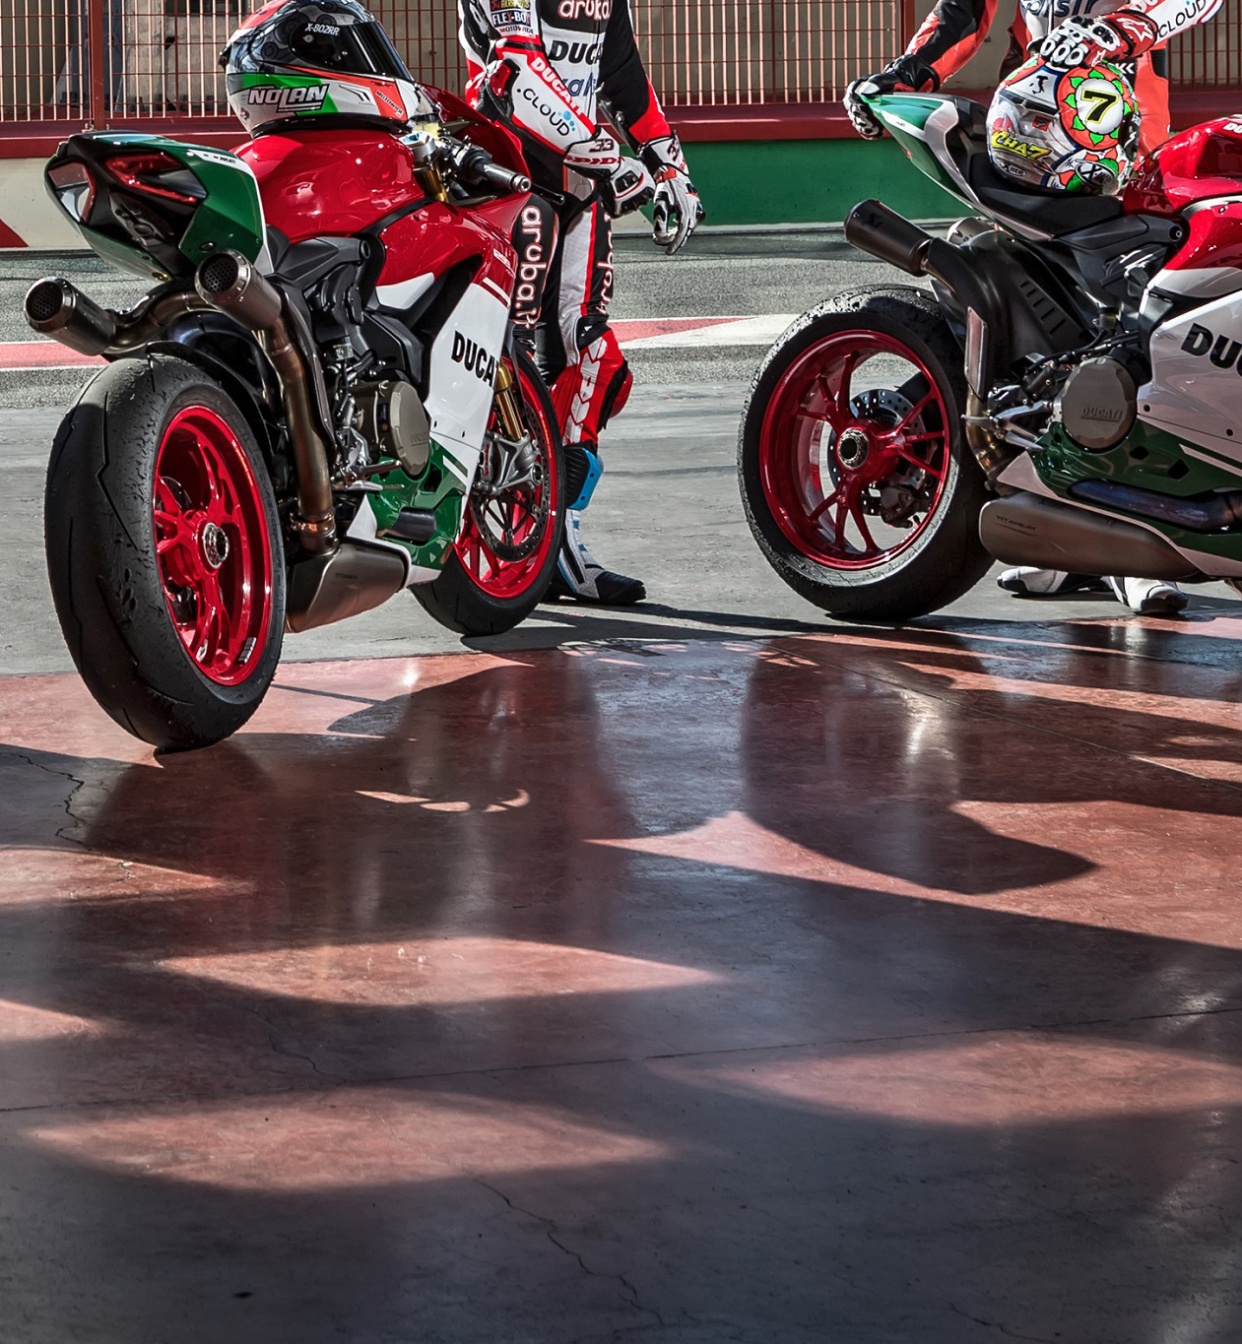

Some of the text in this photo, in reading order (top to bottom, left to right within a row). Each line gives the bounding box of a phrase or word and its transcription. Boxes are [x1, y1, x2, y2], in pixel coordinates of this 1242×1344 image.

[305, 22, 340, 36] X-802RR
[248, 83, 330, 113] NOLAN
[1082, 88, 1118, 126] 7
[1180, 322, 1242, 378] DU
[1083, 406, 1123, 421] DUCATI
